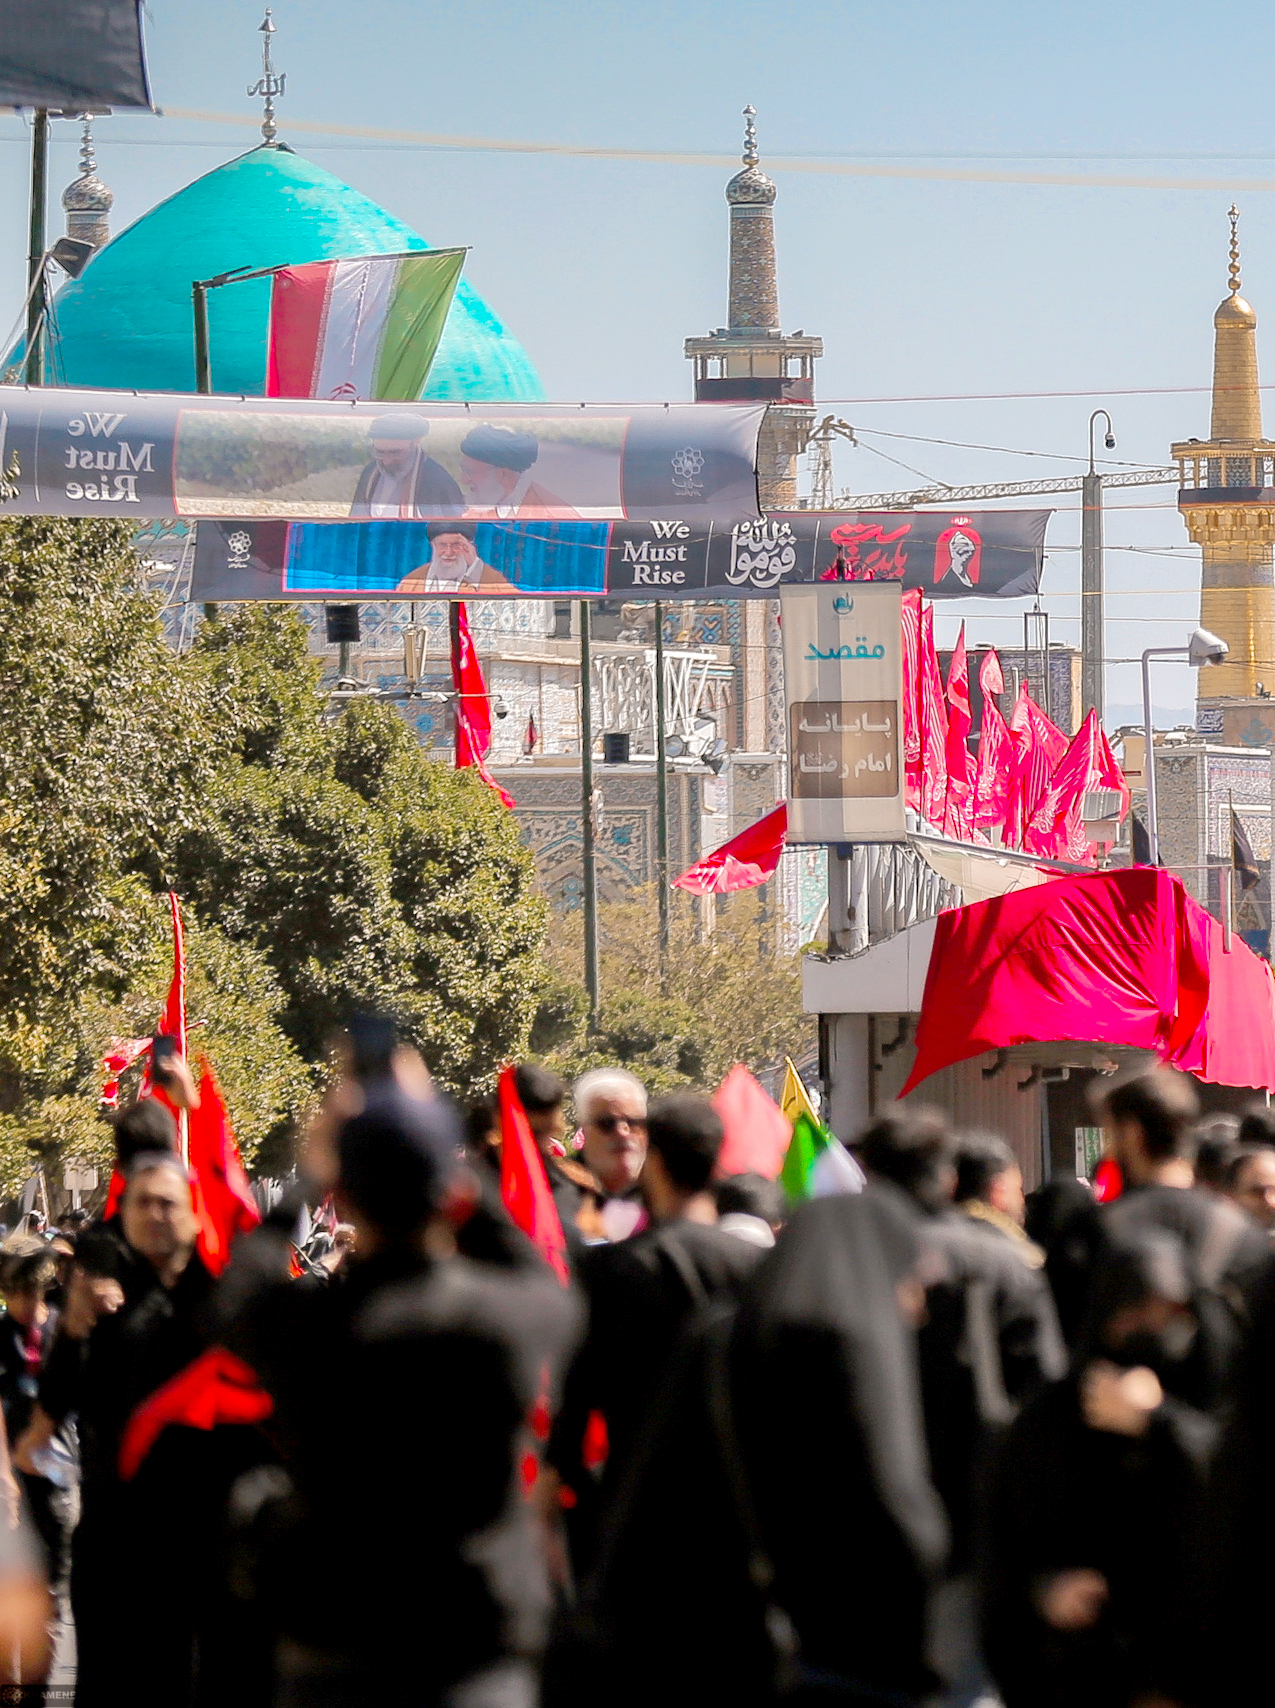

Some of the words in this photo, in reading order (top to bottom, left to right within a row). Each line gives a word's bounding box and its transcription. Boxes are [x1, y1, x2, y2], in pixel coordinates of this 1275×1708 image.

[650, 520, 691, 539] We
[621, 541, 687, 562] Must
[632, 564, 686, 585] Rise
[804, 637, 885, 660] مقصد
[799, 711, 892, 739] پایانه
[799, 752, 849, 779] رضا
[855, 753, 892, 779] امام
